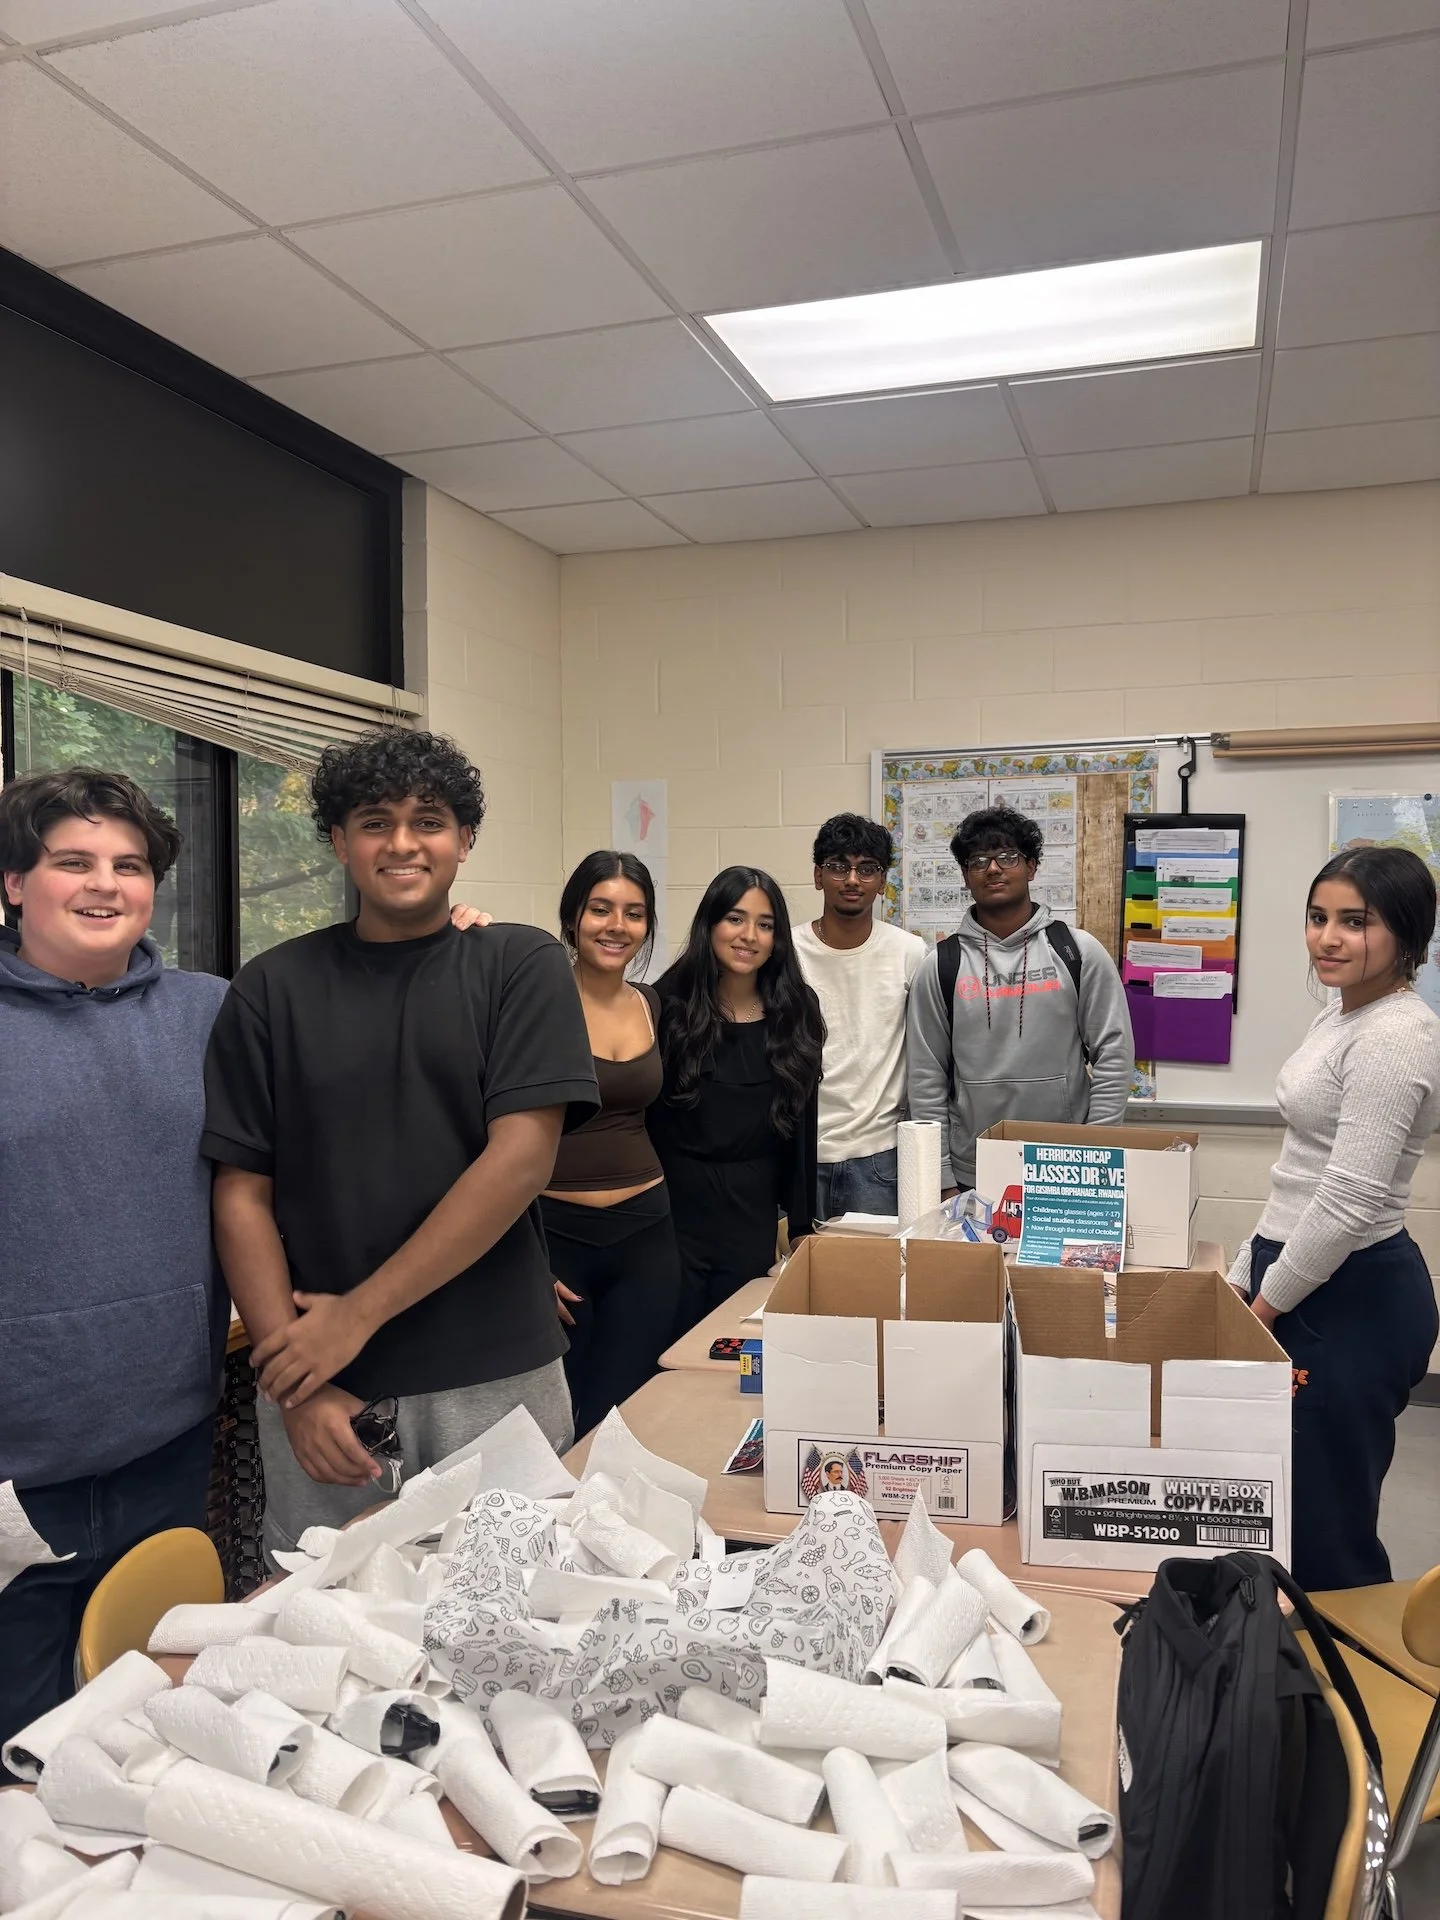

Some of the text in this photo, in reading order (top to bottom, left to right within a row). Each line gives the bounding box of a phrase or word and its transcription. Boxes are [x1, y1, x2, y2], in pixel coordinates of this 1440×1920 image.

[982, 966, 1058, 988] UNDER
[1036, 1148, 1111, 1164] HERRICKS HICAP
[1024, 1163, 1080, 1185] GLASSES
[1024, 1185, 1035, 1194] FOR
[1098, 1189, 1124, 1199] RWANDA
[863, 1452, 962, 1466] FLAGSHIP
[865, 1463, 906, 1471] Premium
[909, 1465, 933, 1473] Copy
[1061, 1480, 1150, 1501] W.B.MASON
[1165, 1481, 1220, 1497] WHITE
[1164, 1496, 1264, 1514] COPY PAPER
[1116, 1512, 1160, 1520] Brightness
[1093, 1523, 1180, 1540] WBP-51200
